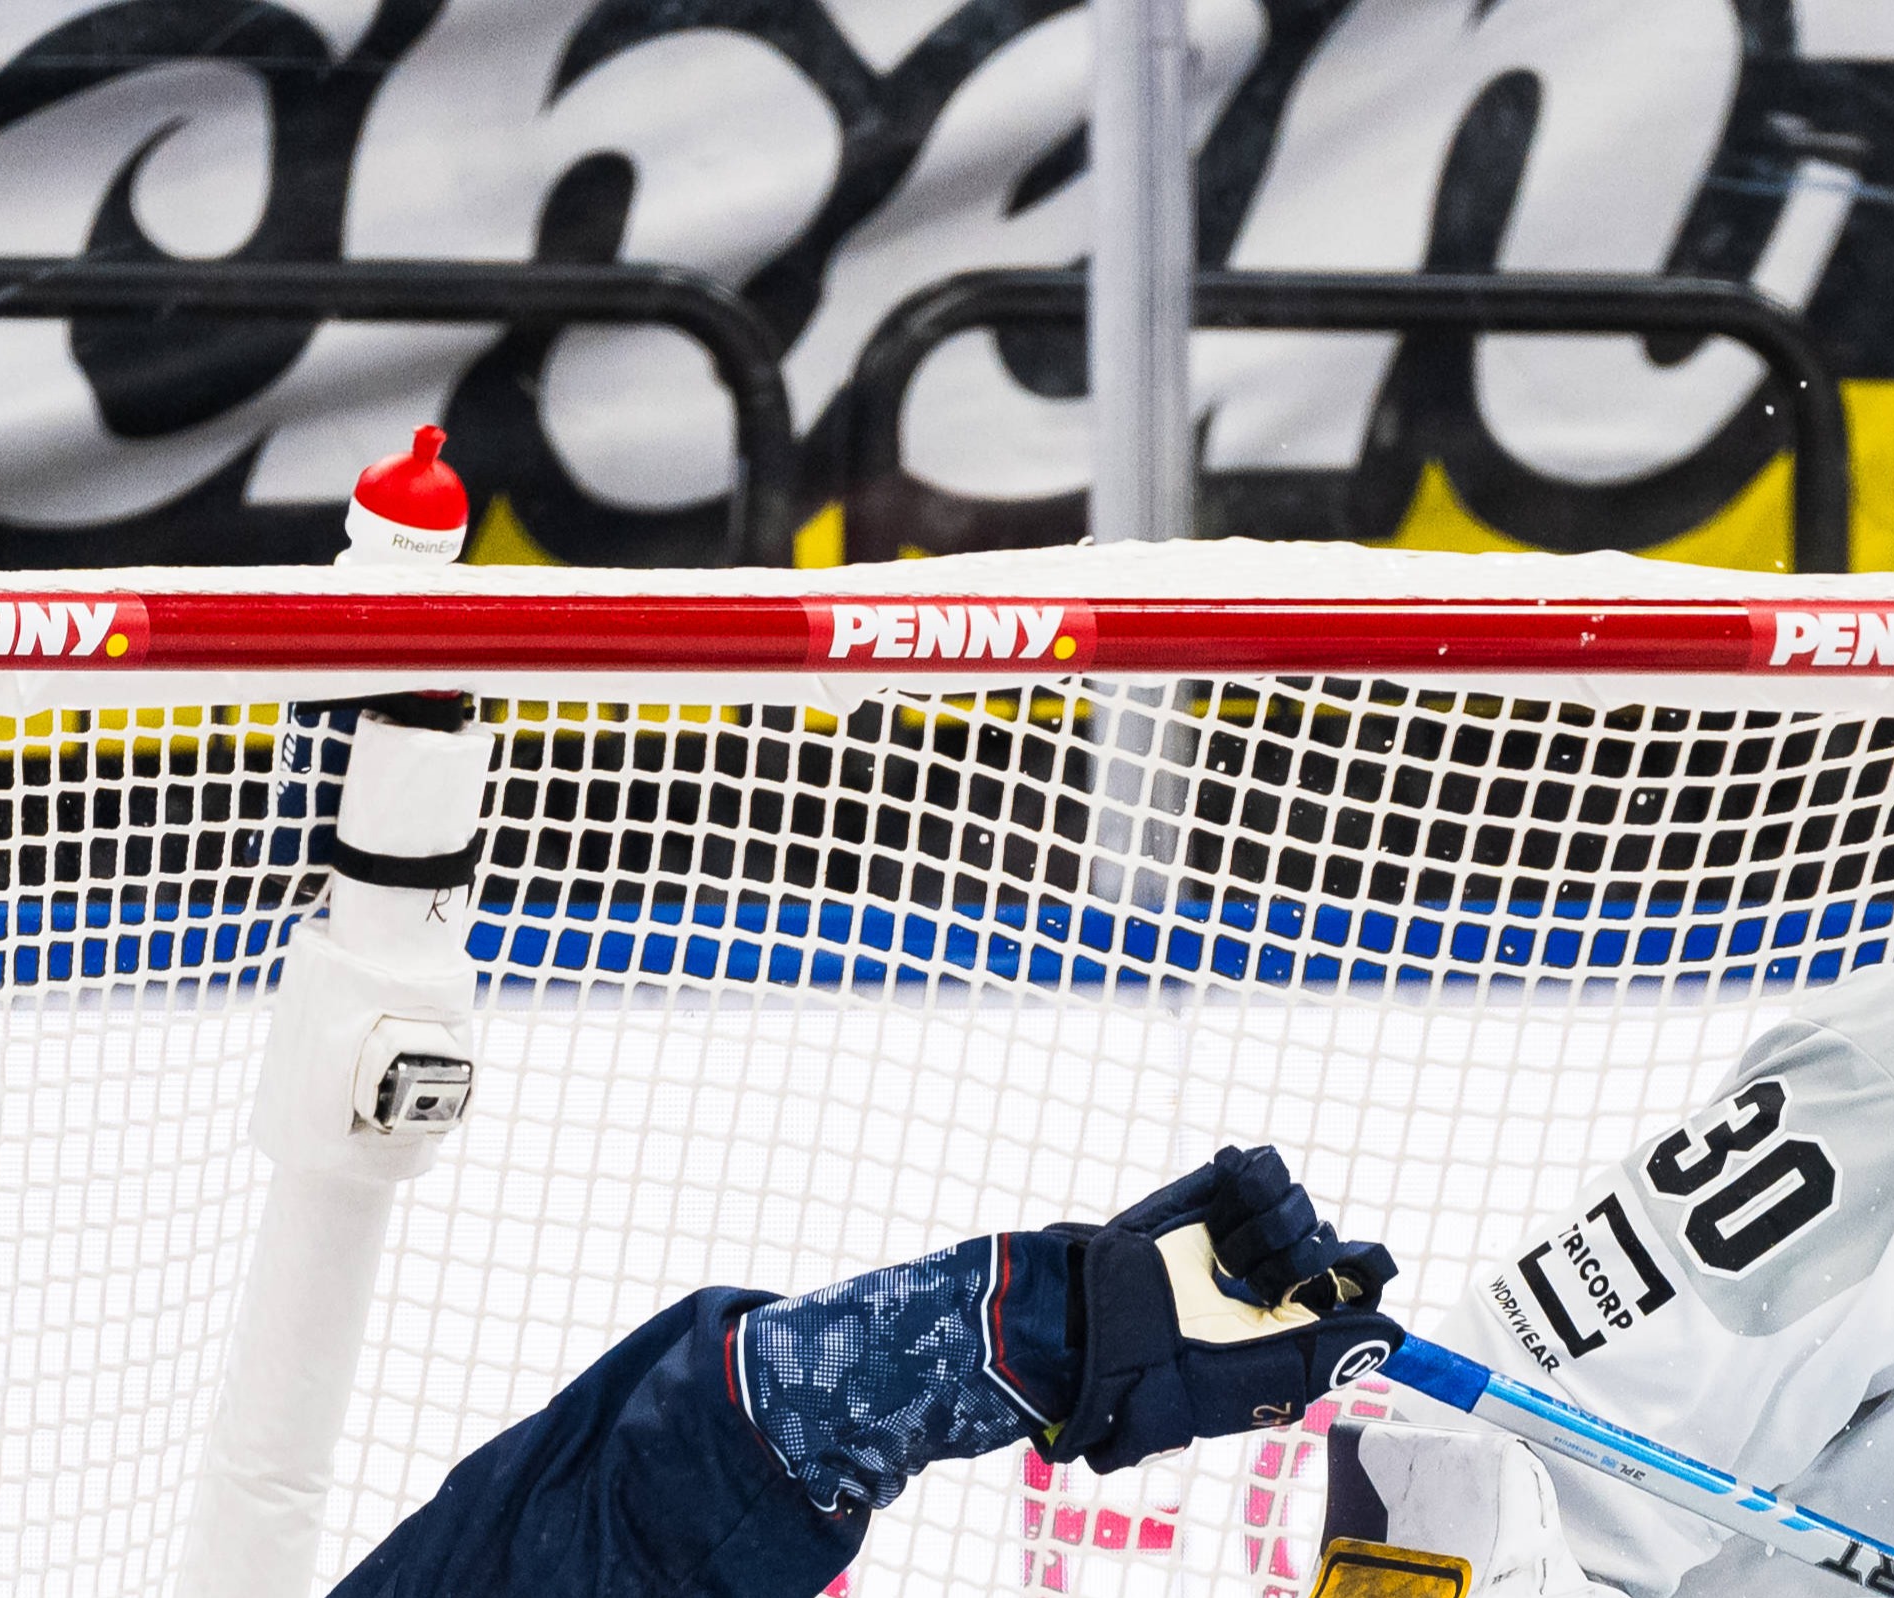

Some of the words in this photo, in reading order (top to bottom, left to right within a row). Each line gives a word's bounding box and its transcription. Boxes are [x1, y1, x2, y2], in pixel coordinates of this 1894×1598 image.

[1639, 1074, 1842, 1281] 30
[1488, 1274, 1560, 1375] WORKWEAR
[1555, 1222, 1633, 1332] TRICORP
